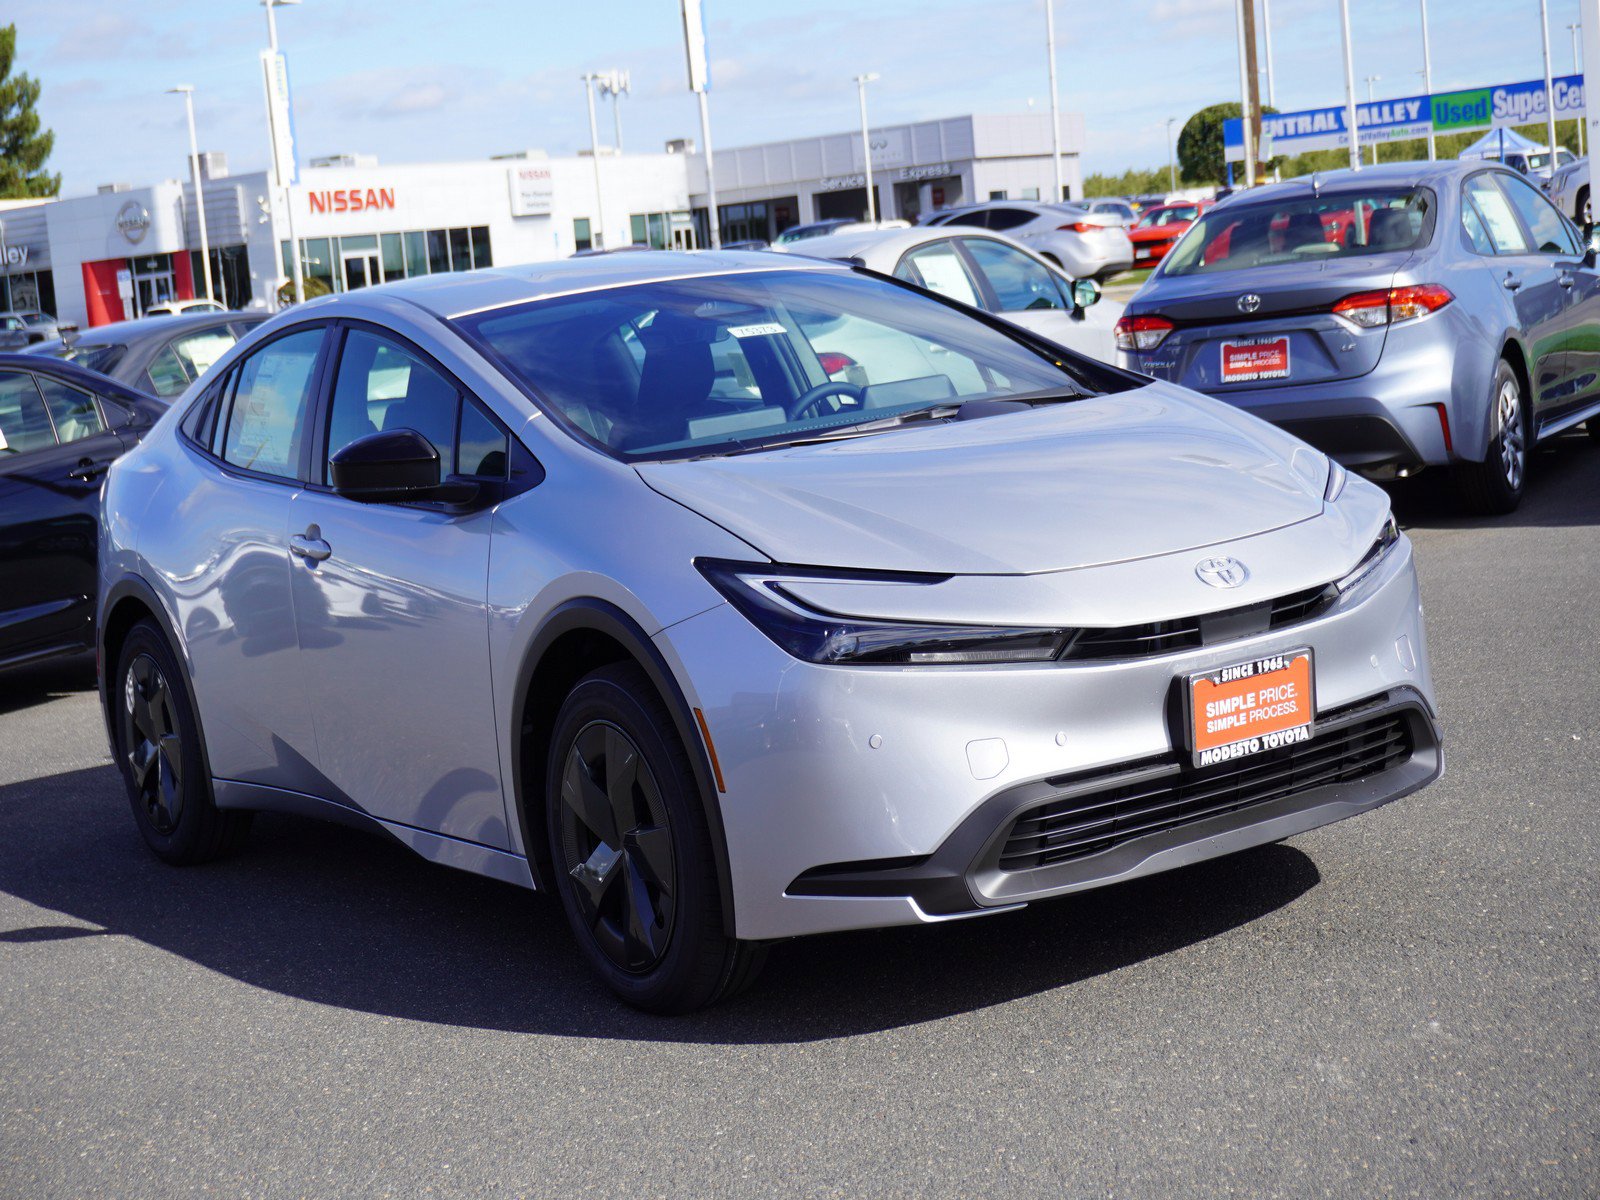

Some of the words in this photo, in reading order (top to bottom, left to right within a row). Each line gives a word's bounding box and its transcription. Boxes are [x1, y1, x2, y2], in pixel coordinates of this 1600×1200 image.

[1435, 96, 1487, 125] Used
[1492, 80, 1586, 121] SupeCe
[1262, 112, 1338, 138] ENTRAL
[820, 175, 865, 190] Service
[899, 164, 951, 180] Express
[308, 187, 396, 214] NISSAN
[1229, 351, 1257, 362] SIMPLE
[1229, 361, 1253, 369] SIMPLE
[1225, 373, 1258, 382] MODESTO
[1259, 369, 1286, 379] TOYOTA
[1221, 663, 1254, 681] SINCE
[1257, 656, 1284, 674] 1965
[1205, 692, 1256, 718] SIMPLE
[1259, 682, 1298, 705] PRICE.
[1206, 713, 1246, 734] SIMPLE
[1249, 700, 1299, 723] PROCESS.
[1200, 738, 1260, 766] MODESTO
[1262, 726, 1309, 749] TOYOTA
